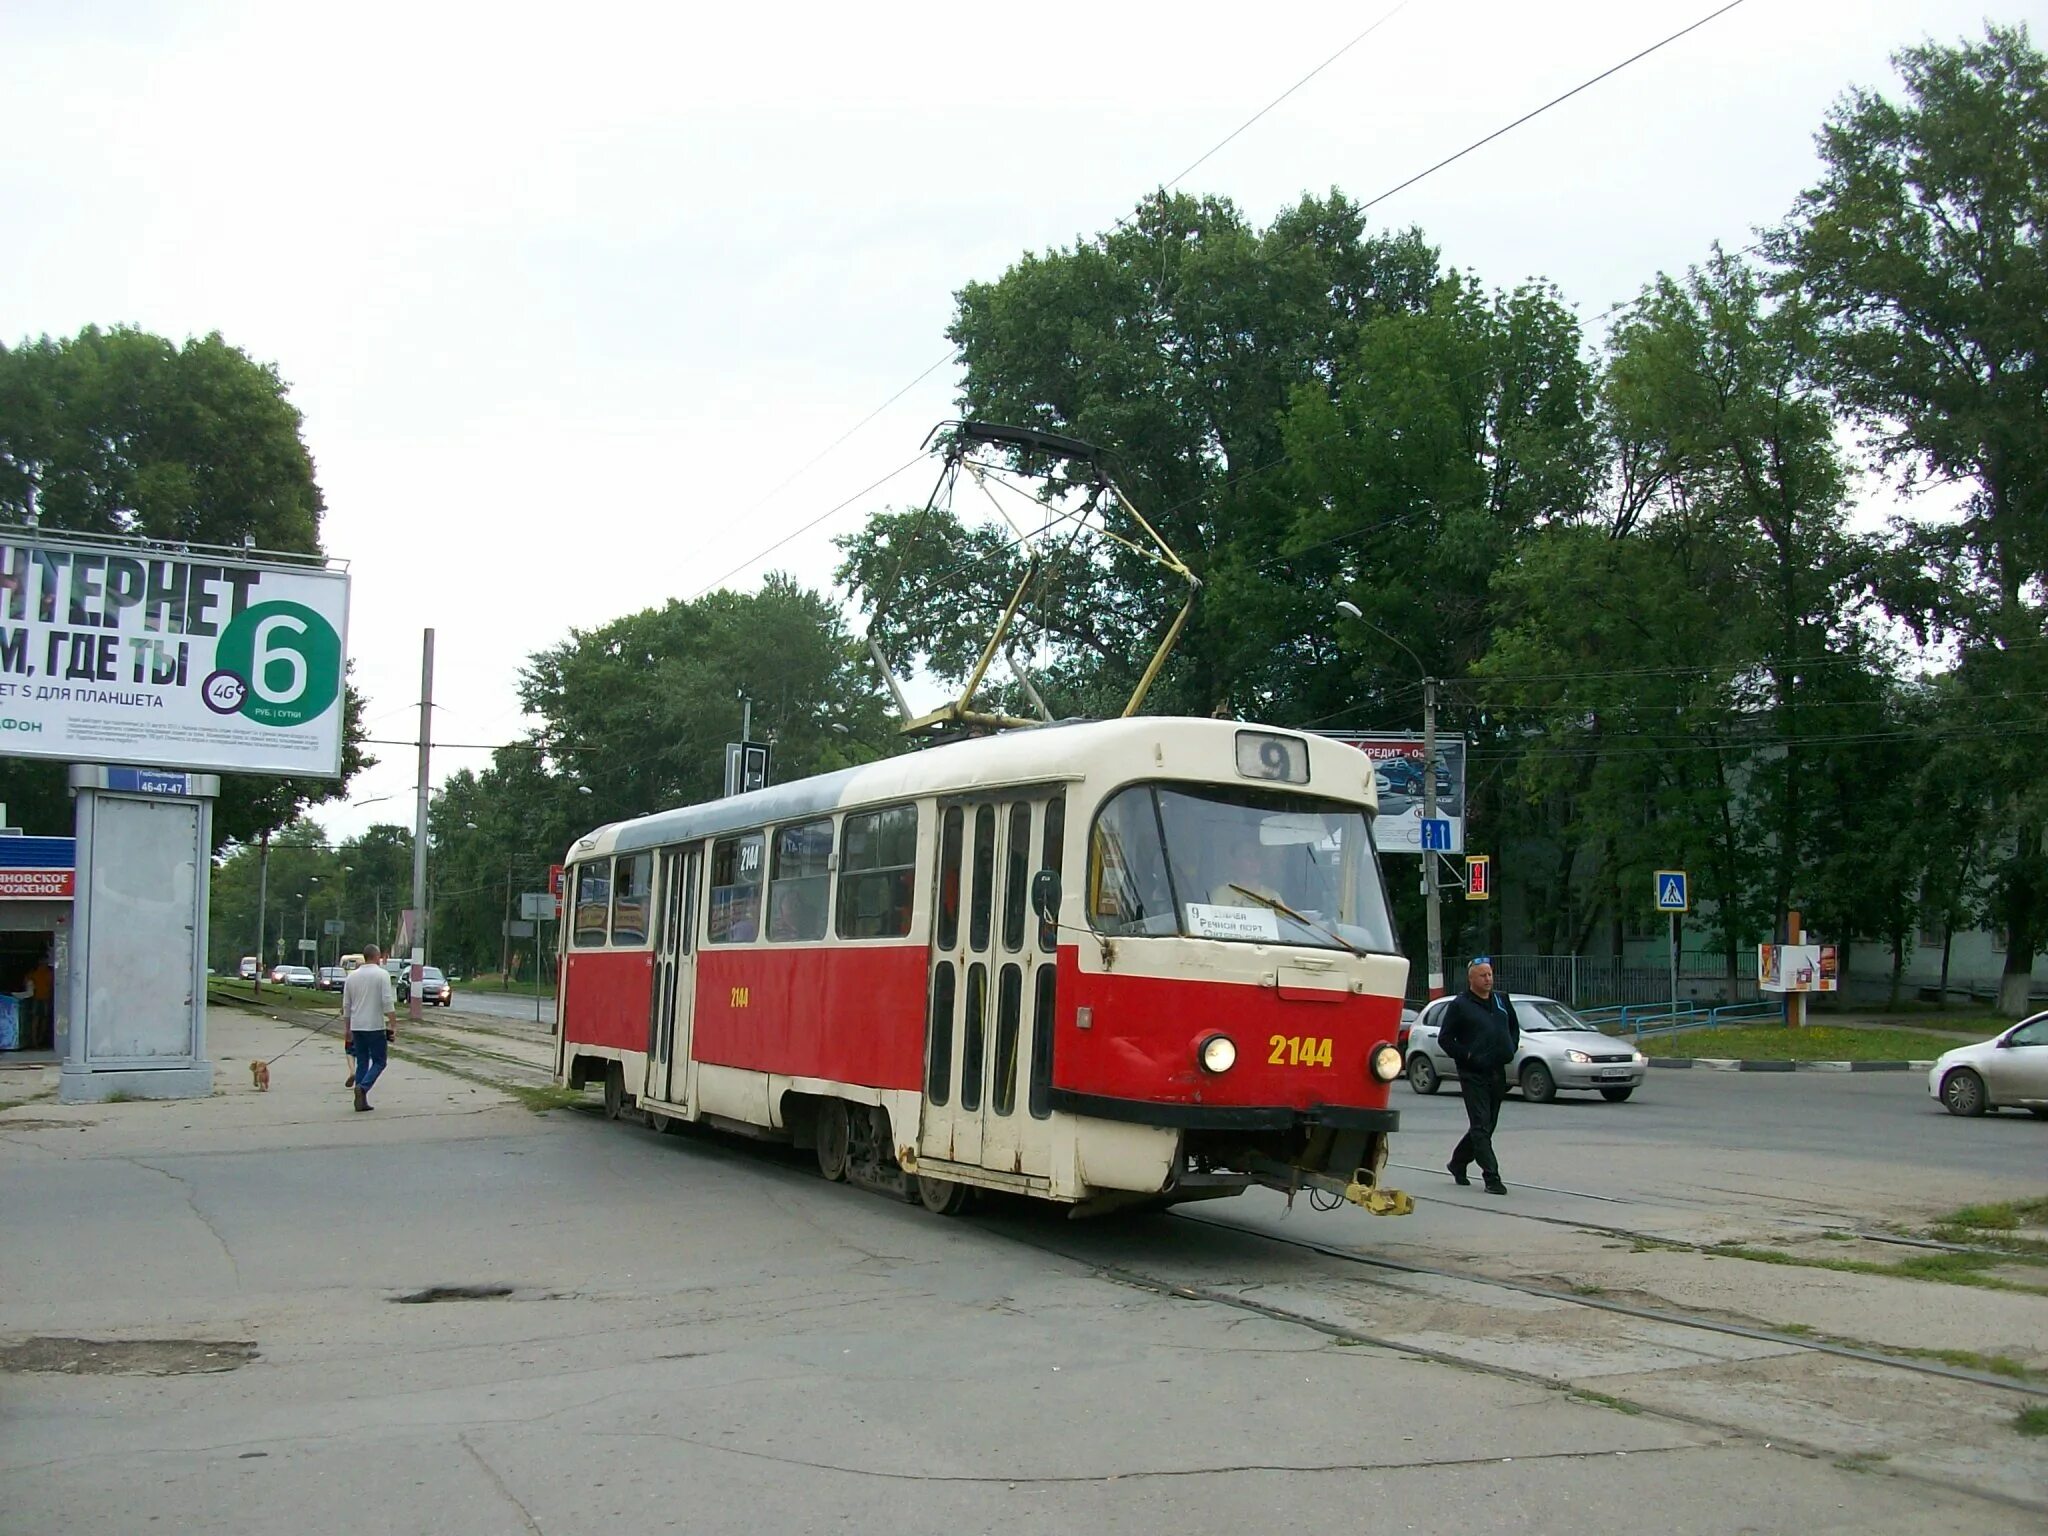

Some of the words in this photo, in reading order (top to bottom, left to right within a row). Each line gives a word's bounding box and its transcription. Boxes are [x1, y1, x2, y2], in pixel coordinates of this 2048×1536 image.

[0, 546, 261, 638] НТЕРНЕТ
[46, 630, 120, 682] ГДЕ
[129, 638, 189, 687] ТЫ
[252, 615, 308, 704] 6
[22, 685, 32, 697] S
[36, 686, 71, 701] ДЛЯ
[76, 689, 164, 707] ПЛАНШЕТА
[0, 718, 42, 732] ФОН
[277, 710, 302, 718] СУТКИ
[1260, 740, 1290, 780] 9
[141, 781, 183, 795] 46-47-47
[740, 845, 760, 871] 2144
[1191, 906, 1200, 919] 9
[730, 987, 749, 1008] 2144
[1268, 1034, 1333, 1067] 2144
